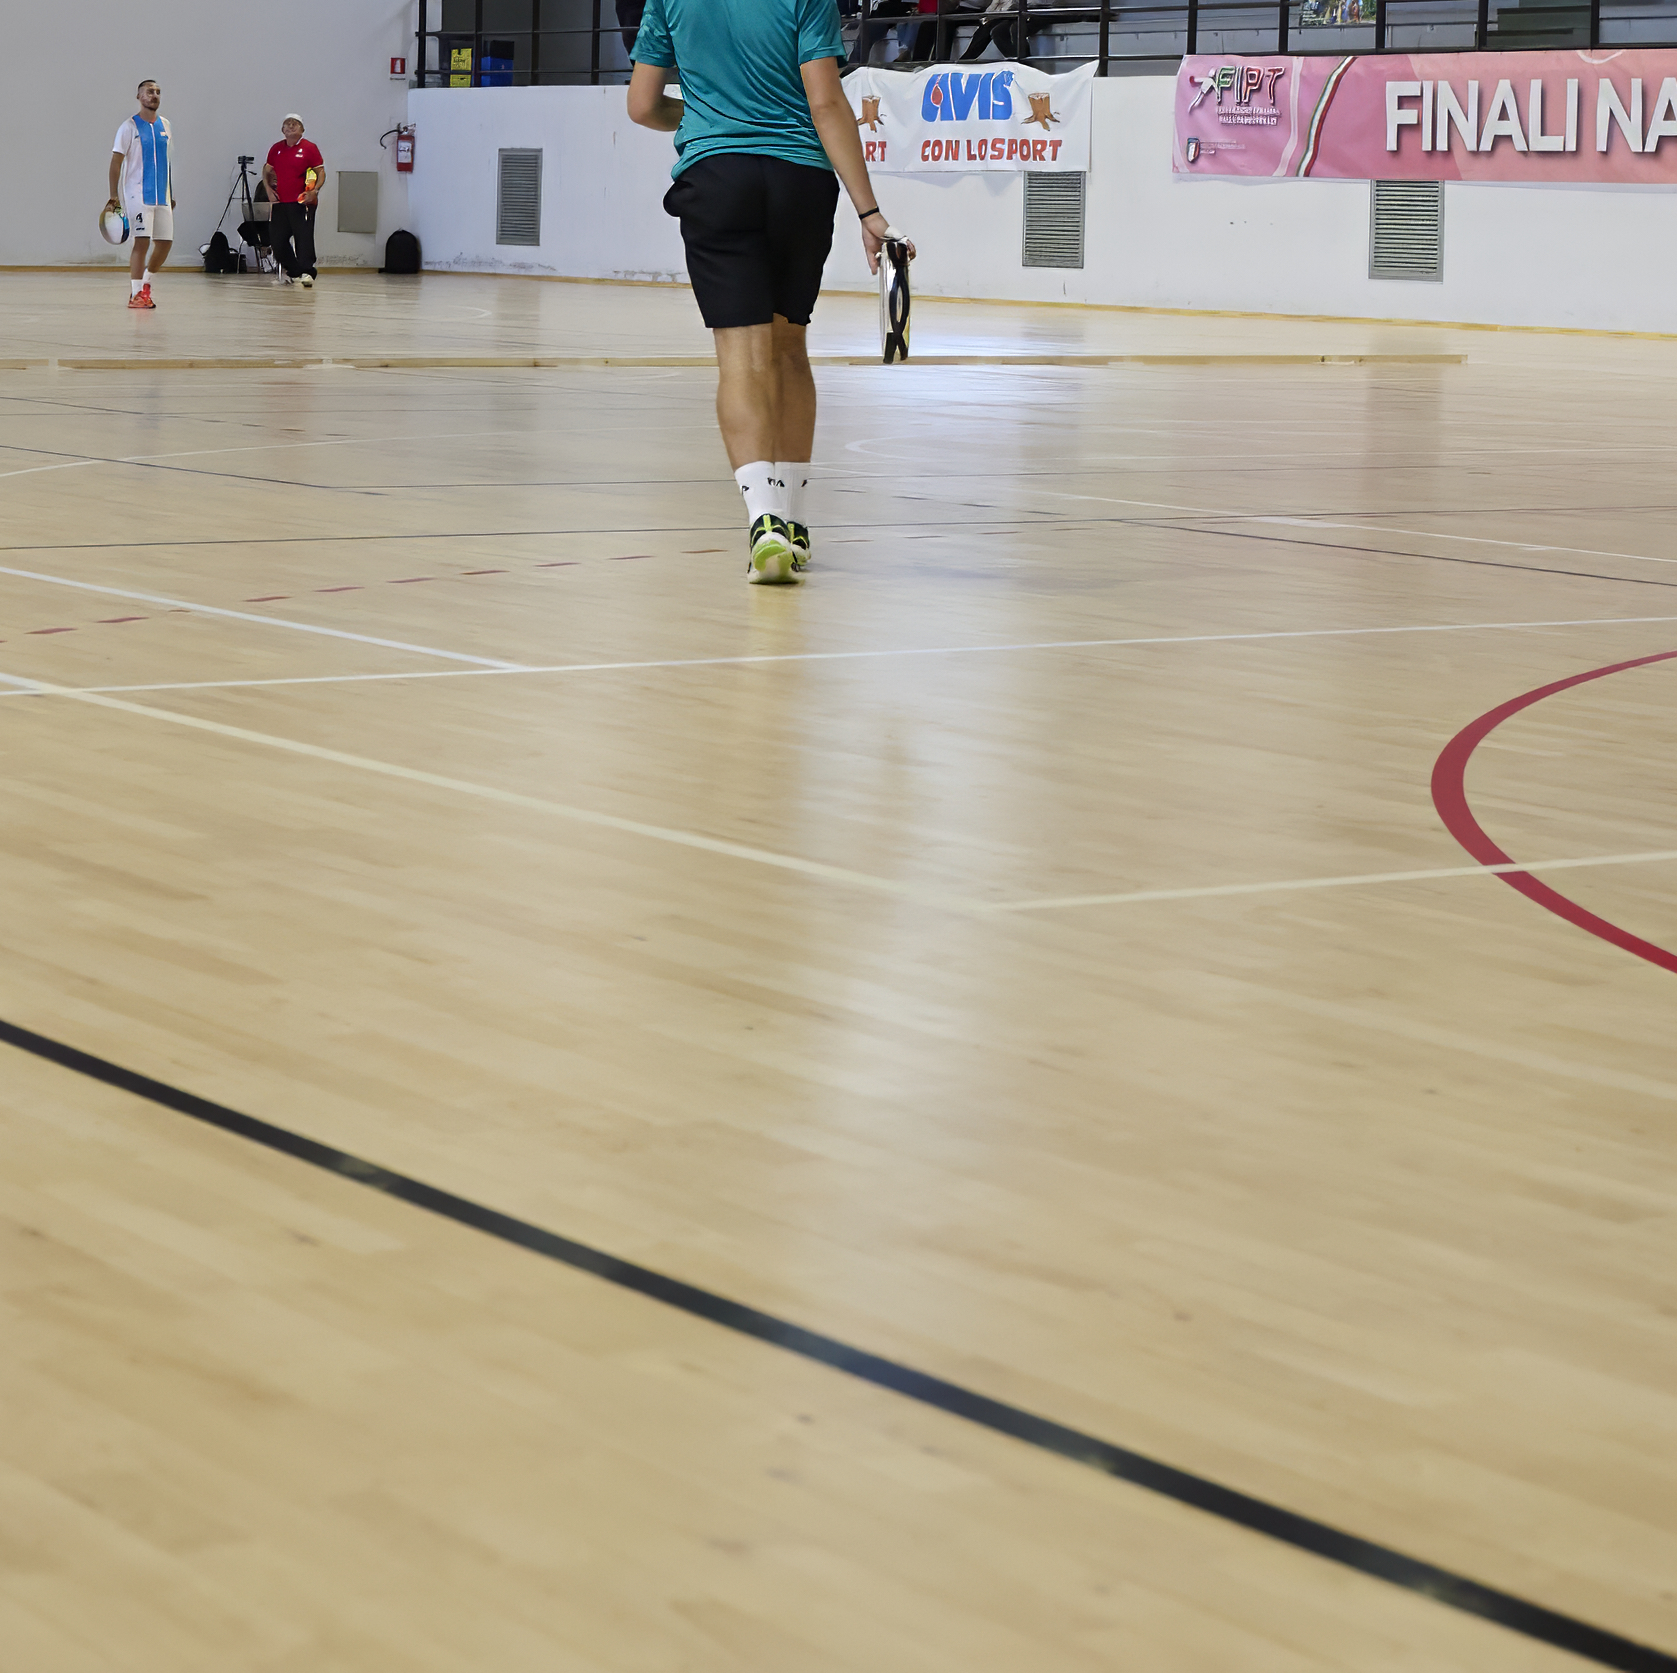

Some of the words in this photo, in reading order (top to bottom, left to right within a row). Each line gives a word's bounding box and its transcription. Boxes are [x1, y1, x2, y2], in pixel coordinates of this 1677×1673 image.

[921, 69, 1016, 123] AVIS
[1216, 65, 1285, 105] FIPT
[1385, 77, 1579, 154] FINALI
[921, 138, 961, 163] CON
[966, 138, 988, 162] LO
[990, 137, 1063, 162] SPORT
